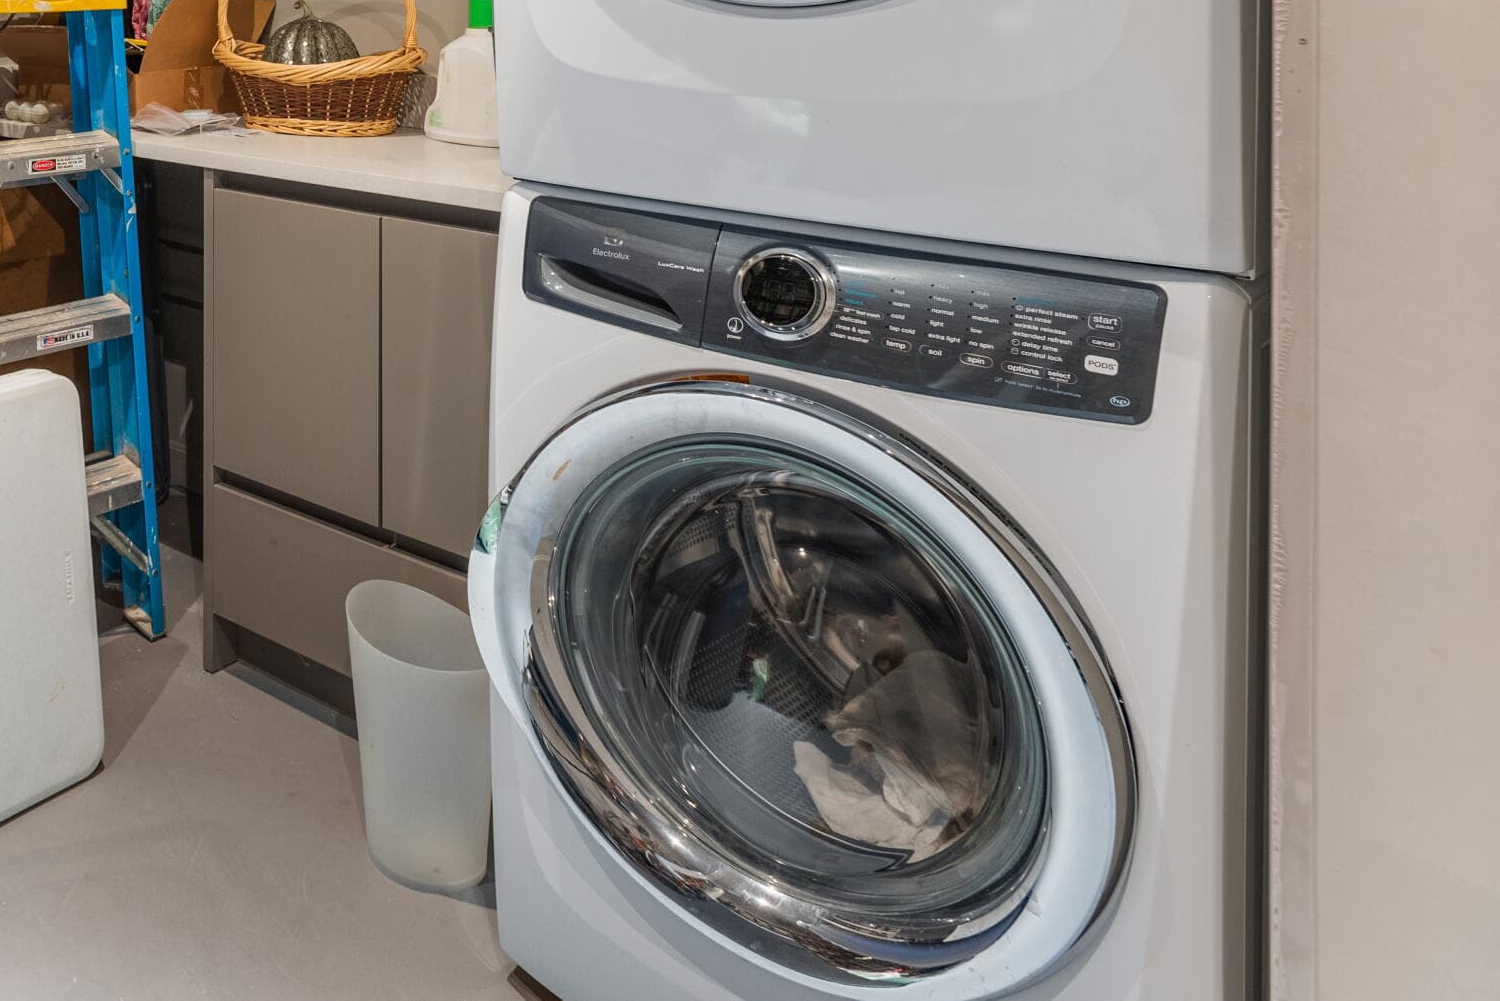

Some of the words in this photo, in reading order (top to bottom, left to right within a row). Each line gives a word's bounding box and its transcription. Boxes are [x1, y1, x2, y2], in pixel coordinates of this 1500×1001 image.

[34, 161, 54, 170] DANGER
[592, 247, 630, 261] Electrolux
[657, 260, 685, 271] LuxCare
[686, 265, 705, 274] Wash
[973, 302, 989, 310] high
[890, 312, 906, 321] cold
[931, 307, 955, 317] normal
[1025, 306, 1053, 317] perfect
[1054, 311, 1079, 321] steam
[840, 315, 867, 326] delicates
[929, 319, 944, 328] light
[971, 315, 1000, 325] medium
[1014, 313, 1033, 322] extra
[1034, 316, 1052, 325] rinse
[1092, 315, 1119, 327] start
[970, 326, 983, 334] low
[1013, 322, 1040, 332] wrinkle
[1040, 326, 1067, 336] release
[847, 335, 869, 344] washer
[927, 332, 945, 341] extra
[1012, 330, 1046, 342] extended
[1047, 336, 1073, 347] refresh
[885, 339, 906, 351] temp
[979, 342, 994, 351] spin
[1021, 340, 1041, 351] delay
[1042, 344, 1059, 353] time
[1091, 339, 1116, 349] cancel
[928, 349, 943, 357] soil
[1020, 350, 1046, 360] control
[1047, 354, 1063, 363] lock
[967, 356, 986, 366] spin
[1007, 364, 1040, 377] options
[1047, 370, 1071, 380] select
